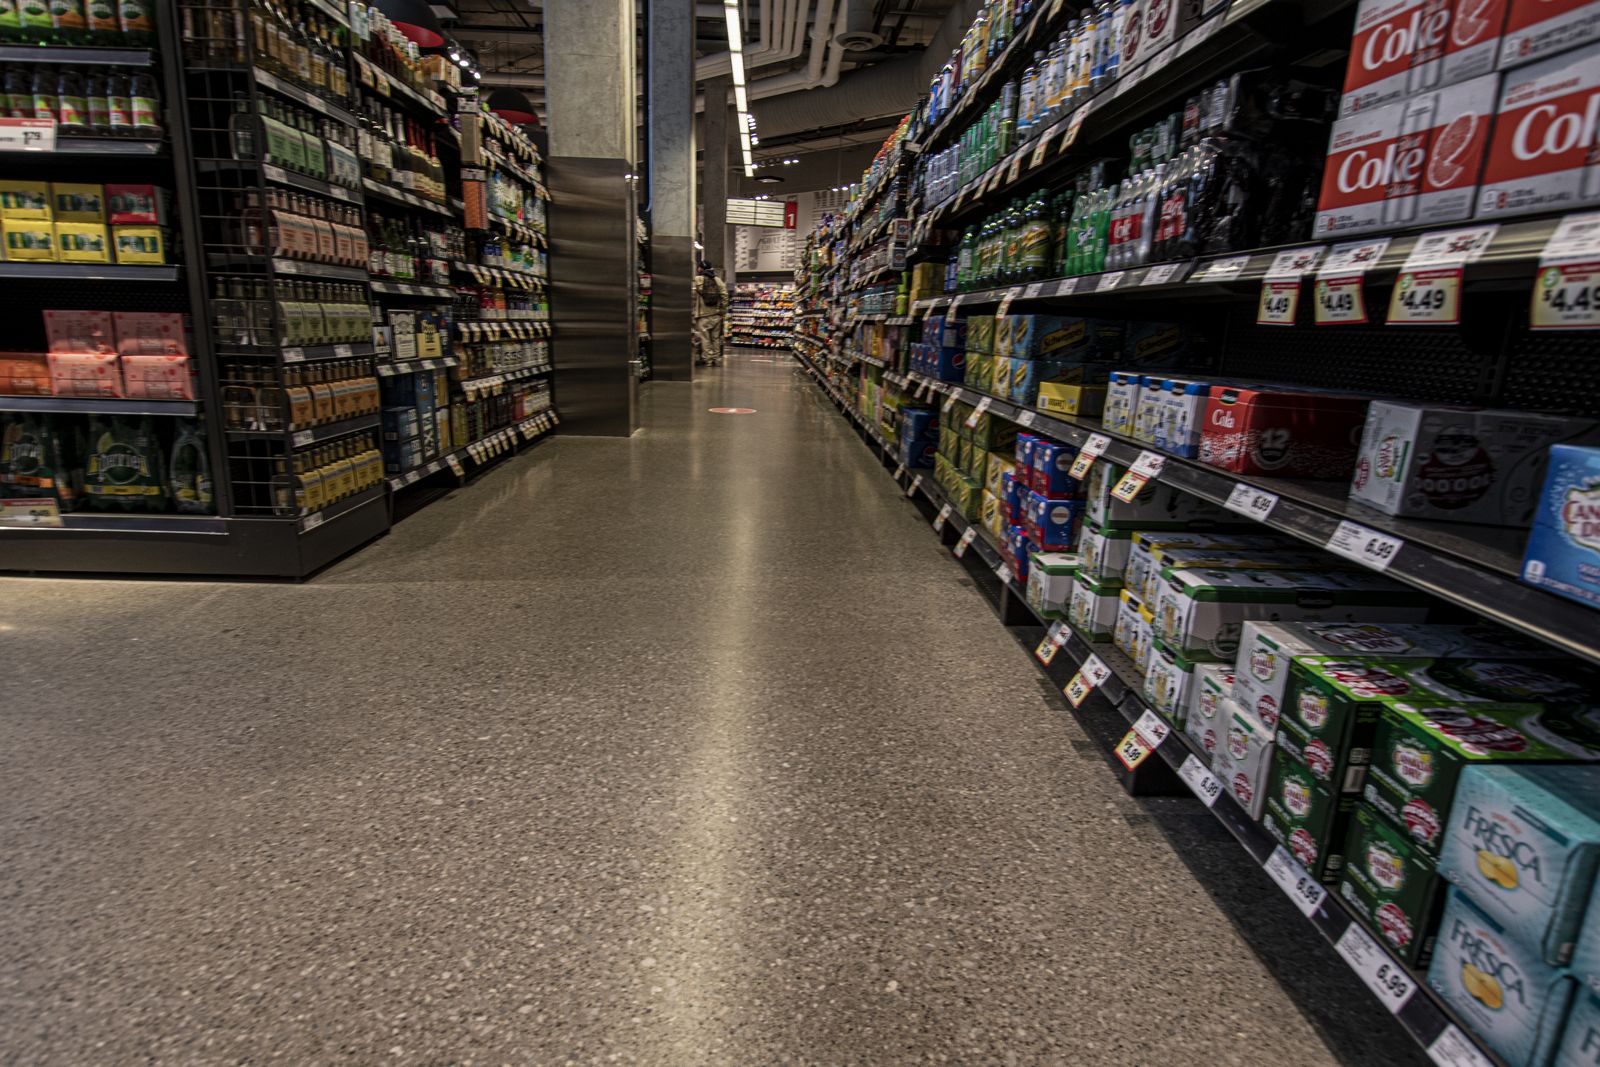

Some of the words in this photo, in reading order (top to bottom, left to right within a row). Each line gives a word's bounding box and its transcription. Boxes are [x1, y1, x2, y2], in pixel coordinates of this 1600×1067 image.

[1362, 9, 1450, 71] Coke
[1337, 143, 1426, 193] Coke
[787, 213, 795, 227] 1
[1212, 409, 1236, 428] Cola
[1262, 428, 1290, 449] 12
[1364, 538, 1395, 559] 6.99
[1463, 805, 1542, 883] FRESCA
[1296, 876, 1320, 905] 6.99
[1451, 918, 1526, 1004] FRESCA
[1376, 963, 1408, 998] 6.99
